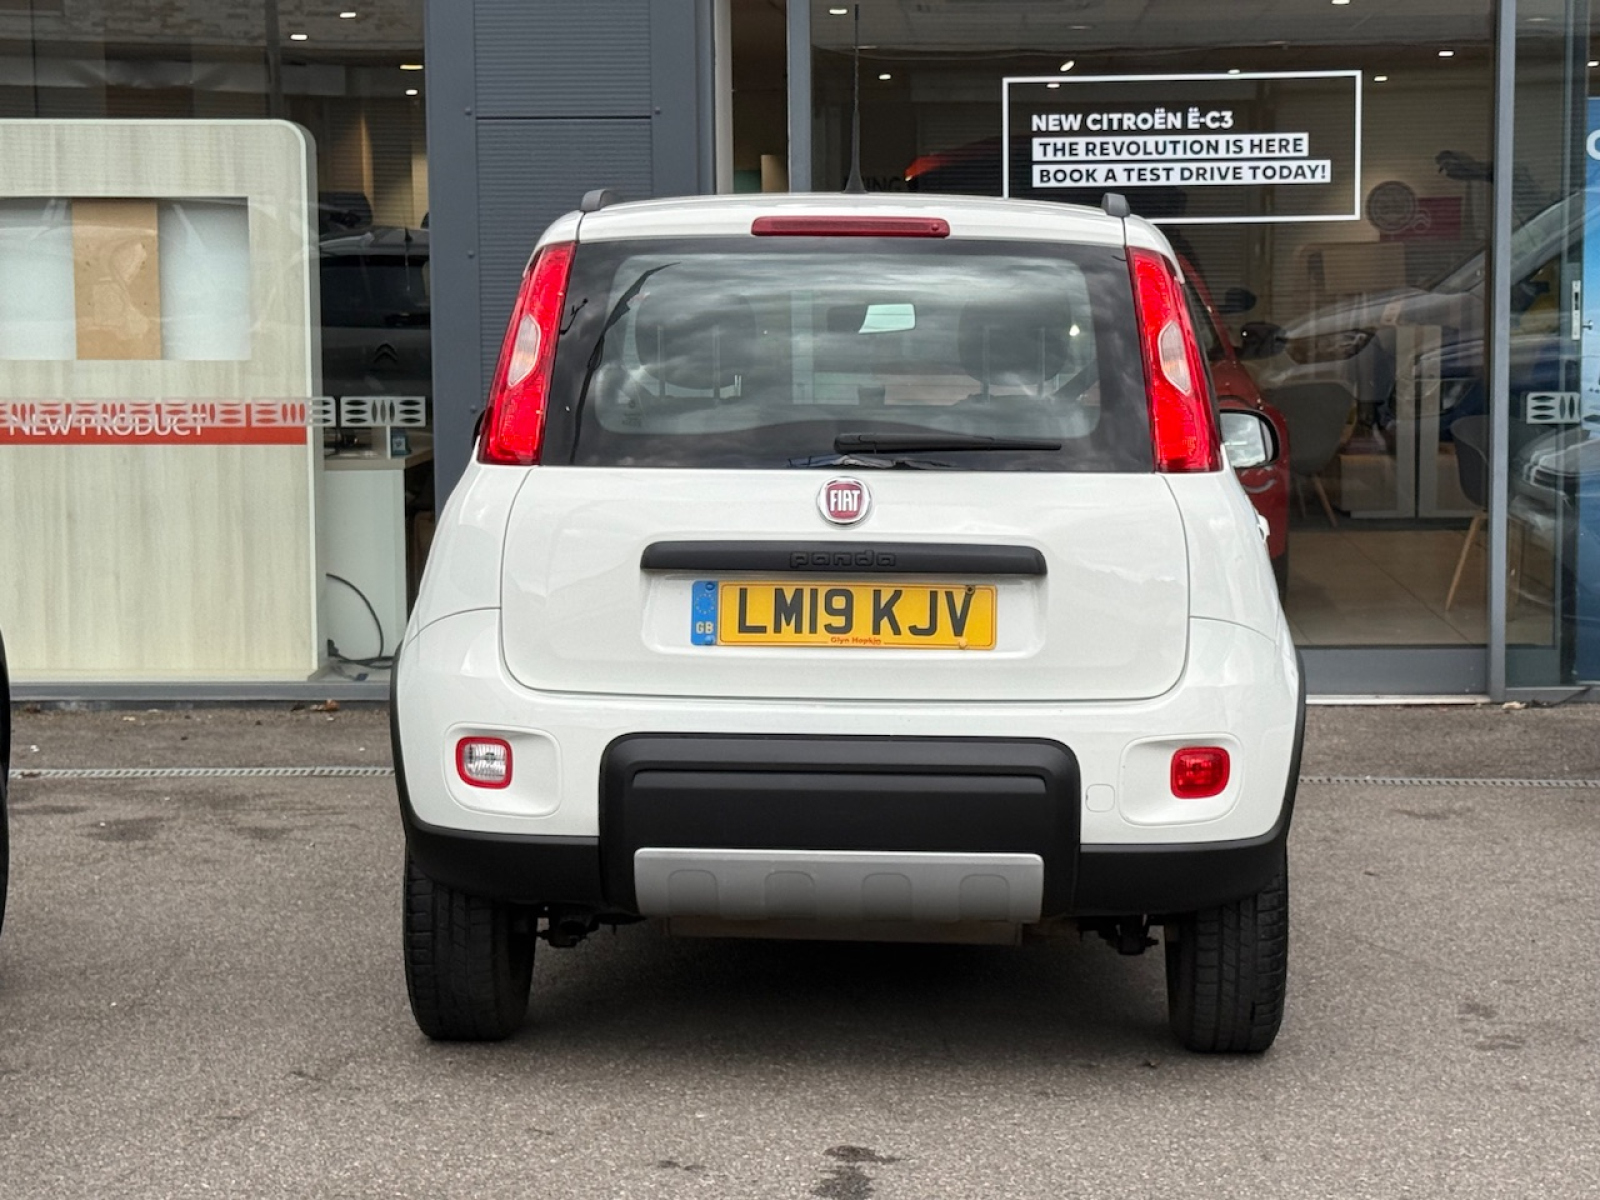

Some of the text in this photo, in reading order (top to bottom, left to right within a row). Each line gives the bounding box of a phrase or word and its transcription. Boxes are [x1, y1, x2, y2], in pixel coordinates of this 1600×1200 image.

[1031, 107, 1234, 132] NEW CITROËN Ë-C3
[1039, 138, 1304, 157] THE REVOLUTION IS HERE
[1039, 164, 1327, 184] BOOK A TEST DRIVE TODAY!
[9, 413, 207, 436] NEW PRODUCT
[829, 489, 861, 512] FIAT
[789, 550, 896, 569] panda
[738, 587, 972, 637] LM19 KJV
[695, 621, 714, 635] GB
